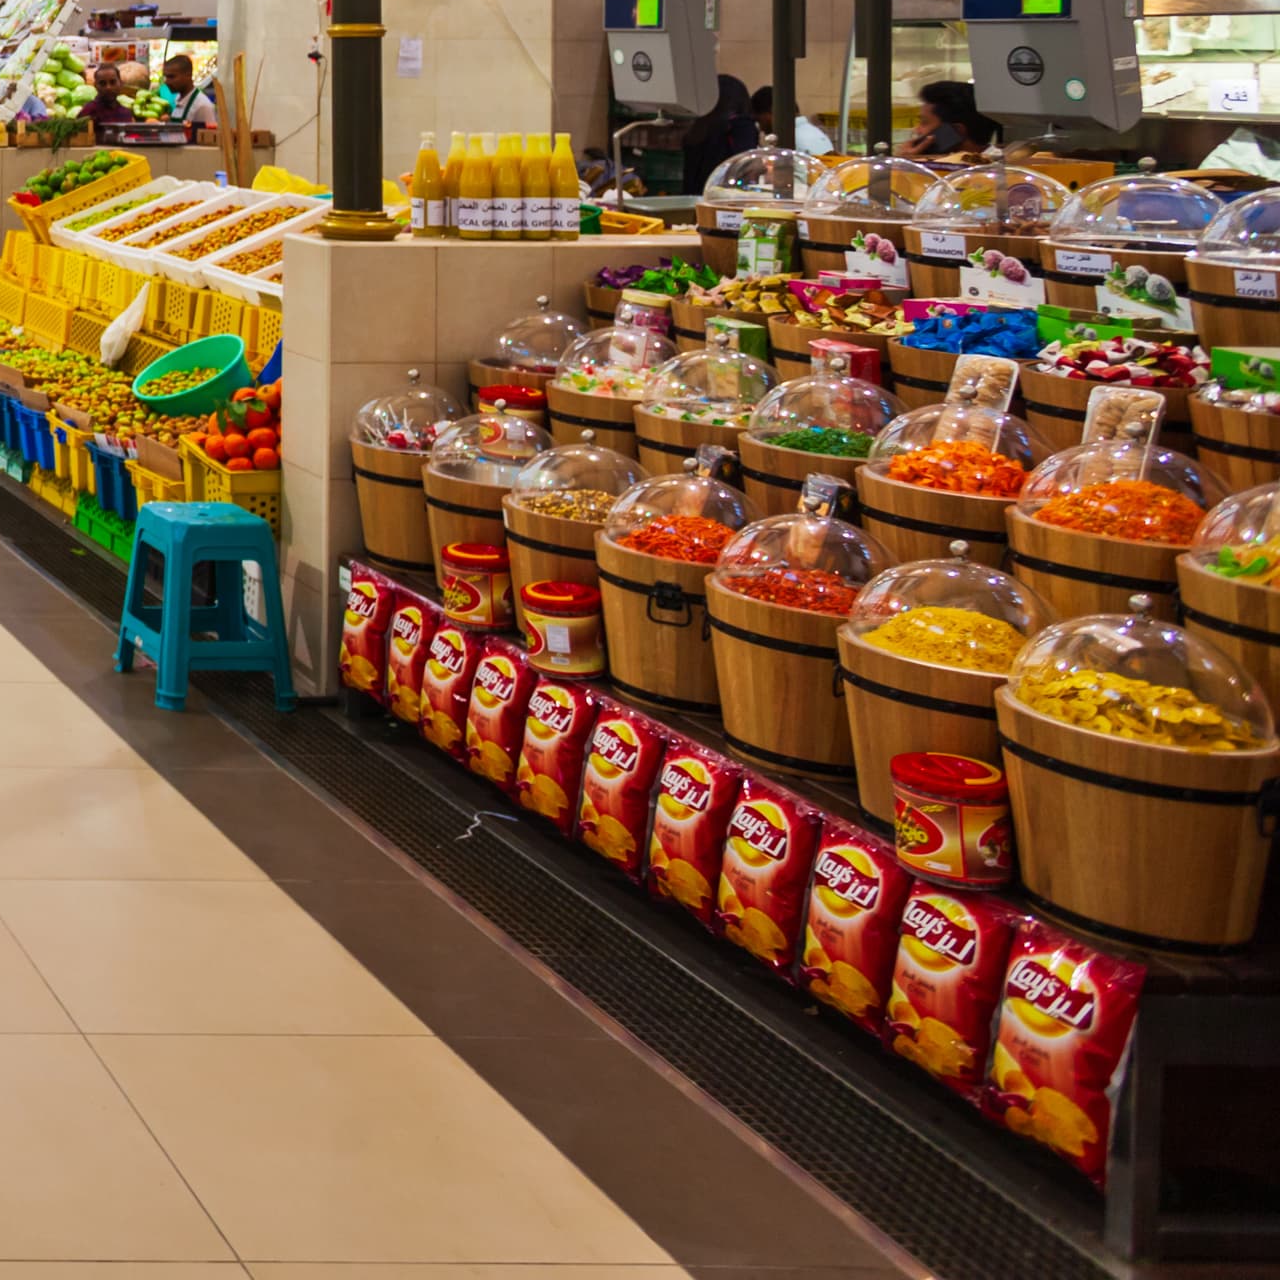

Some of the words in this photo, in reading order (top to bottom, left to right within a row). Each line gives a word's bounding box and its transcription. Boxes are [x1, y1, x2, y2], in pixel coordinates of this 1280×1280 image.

[815, 853, 855, 887] Lay's
[903, 901, 947, 938] Lay's
[1007, 961, 1061, 1001] Lay's
